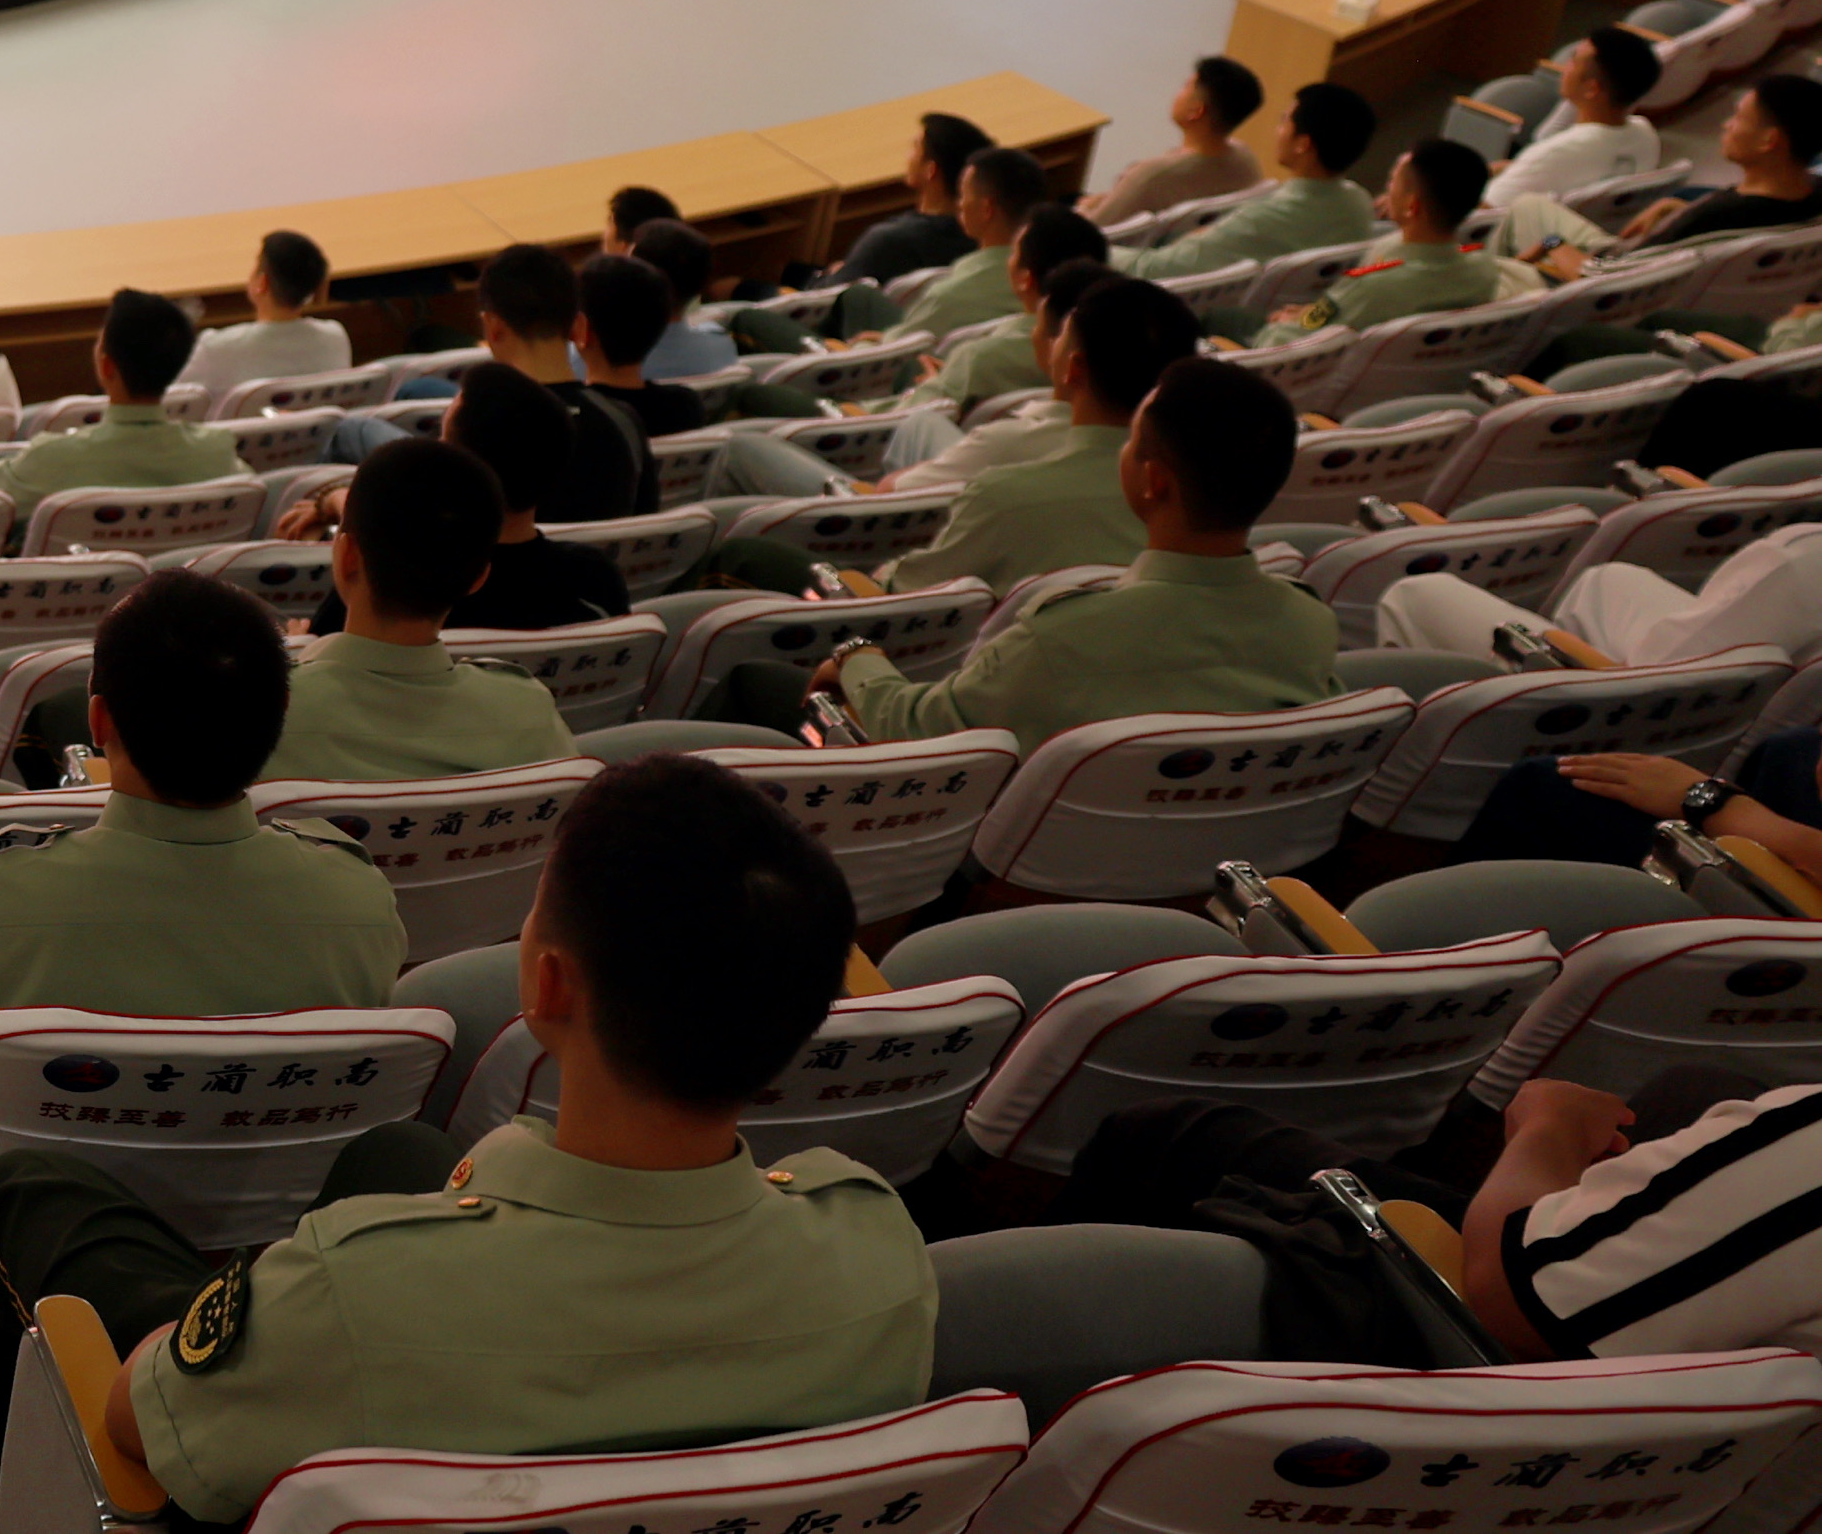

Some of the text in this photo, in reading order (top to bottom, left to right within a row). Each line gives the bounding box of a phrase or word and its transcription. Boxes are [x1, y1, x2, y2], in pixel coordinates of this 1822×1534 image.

[801, 1026, 975, 1070] 蔺职高
[144, 1057, 380, 1095] 古蔺职高
[1420, 1438, 1739, 1489] 古蔺职高
